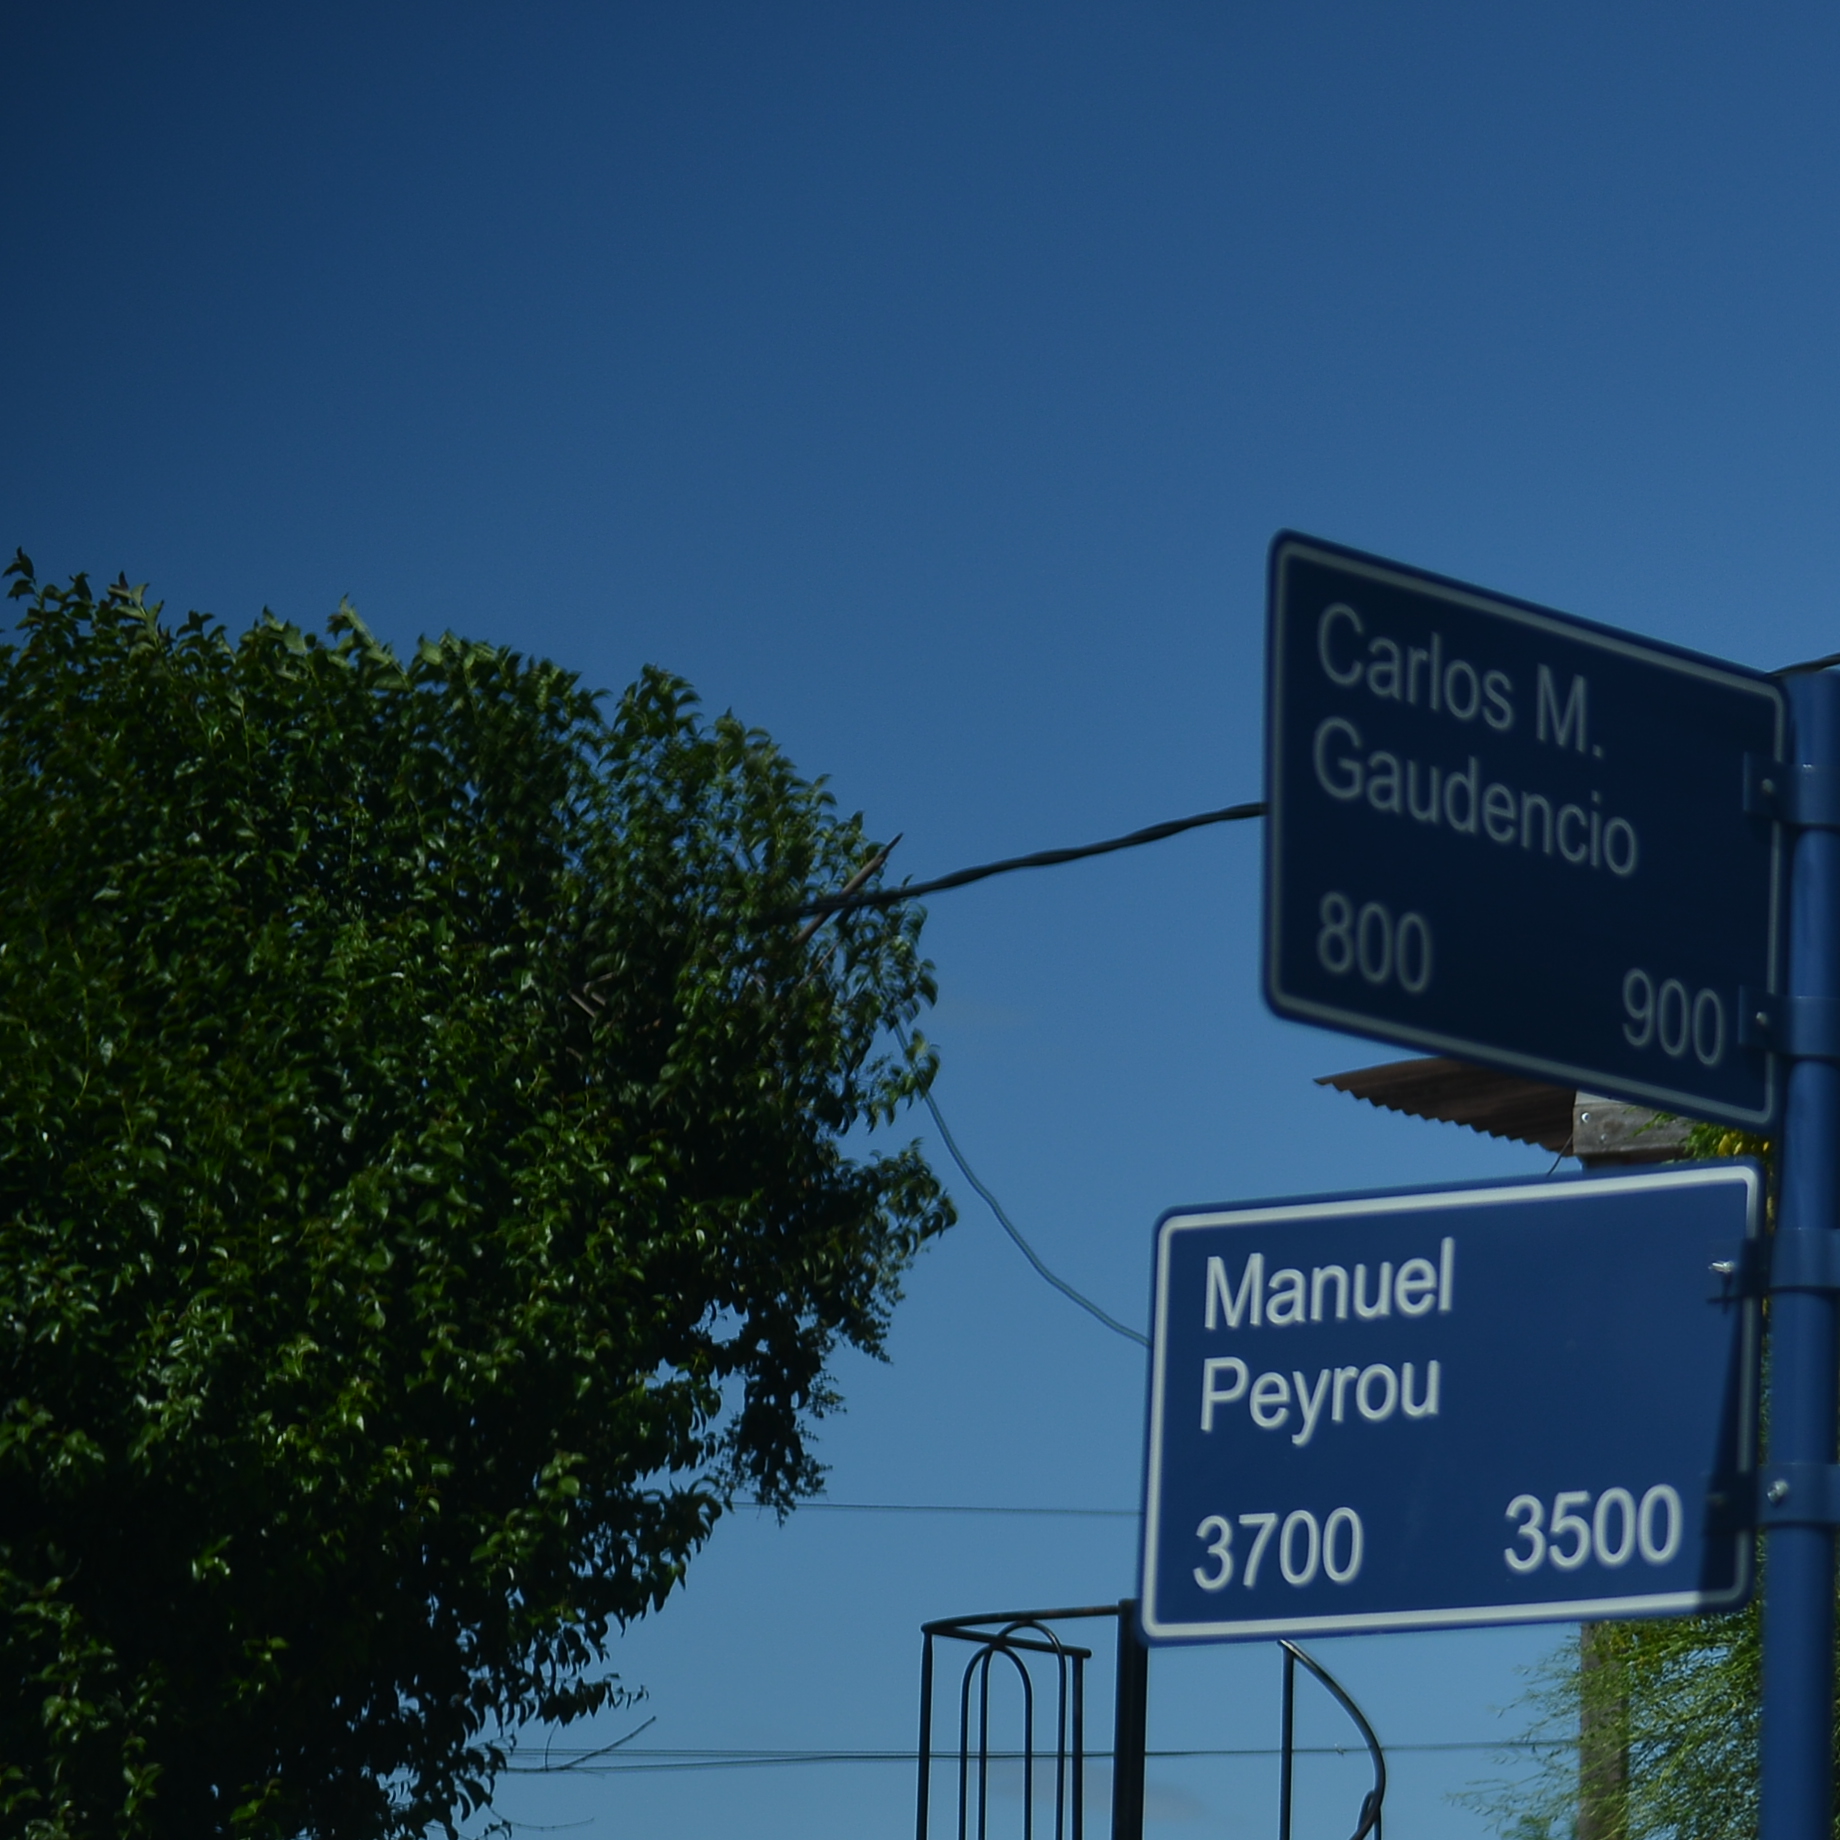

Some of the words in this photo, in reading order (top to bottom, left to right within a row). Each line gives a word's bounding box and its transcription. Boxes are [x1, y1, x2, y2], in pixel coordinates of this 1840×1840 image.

[1316, 602, 1515, 733] Carlos
[1535, 663, 1605, 760] M.
[1312, 715, 1640, 879] Gaudencio
[1316, 890, 1434, 996] 800
[1620, 966, 1726, 1069] 900
[1203, 1235, 1456, 1332] Manuel
[1199, 1355, 1442, 1448] Peyrou
[1192, 1505, 1365, 1592] 3700
[1502, 1483, 1683, 1574] 3500
